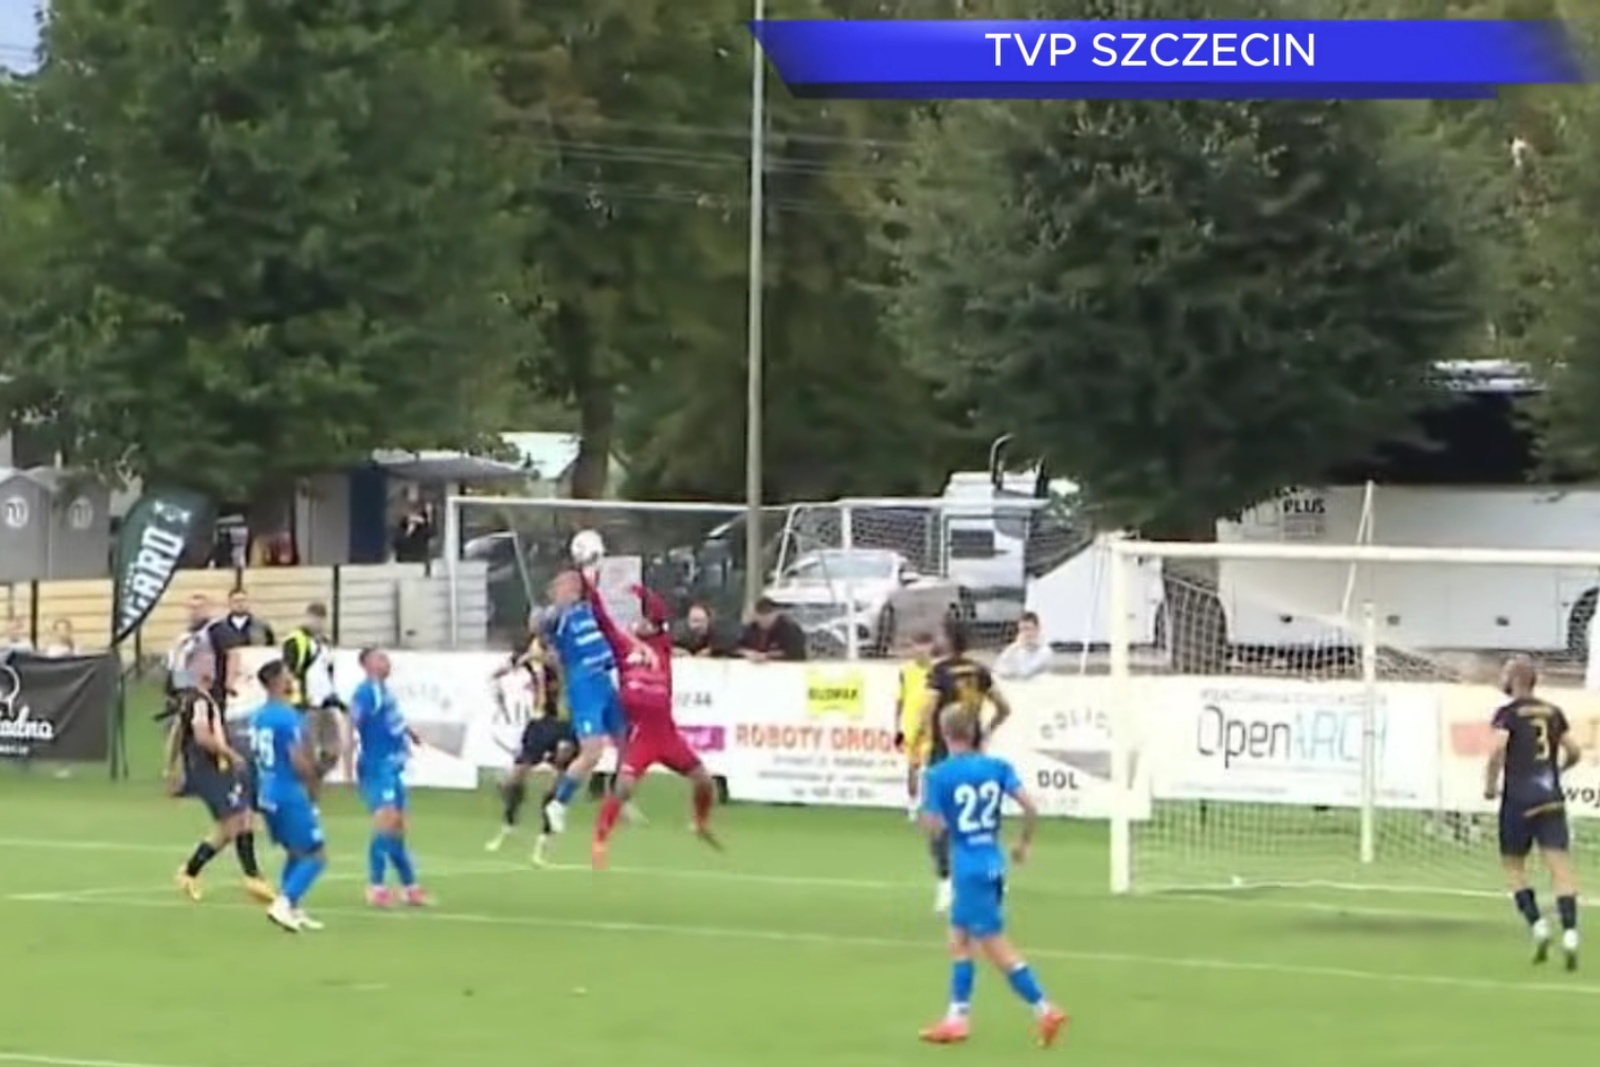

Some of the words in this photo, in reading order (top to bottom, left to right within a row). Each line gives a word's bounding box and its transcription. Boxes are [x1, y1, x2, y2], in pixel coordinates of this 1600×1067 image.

[1283, 498, 1326, 514] PLUS
[736, 724, 823, 750] ROBOTY
[1531, 716, 1550, 760] 3
[954, 780, 1001, 832] 22
